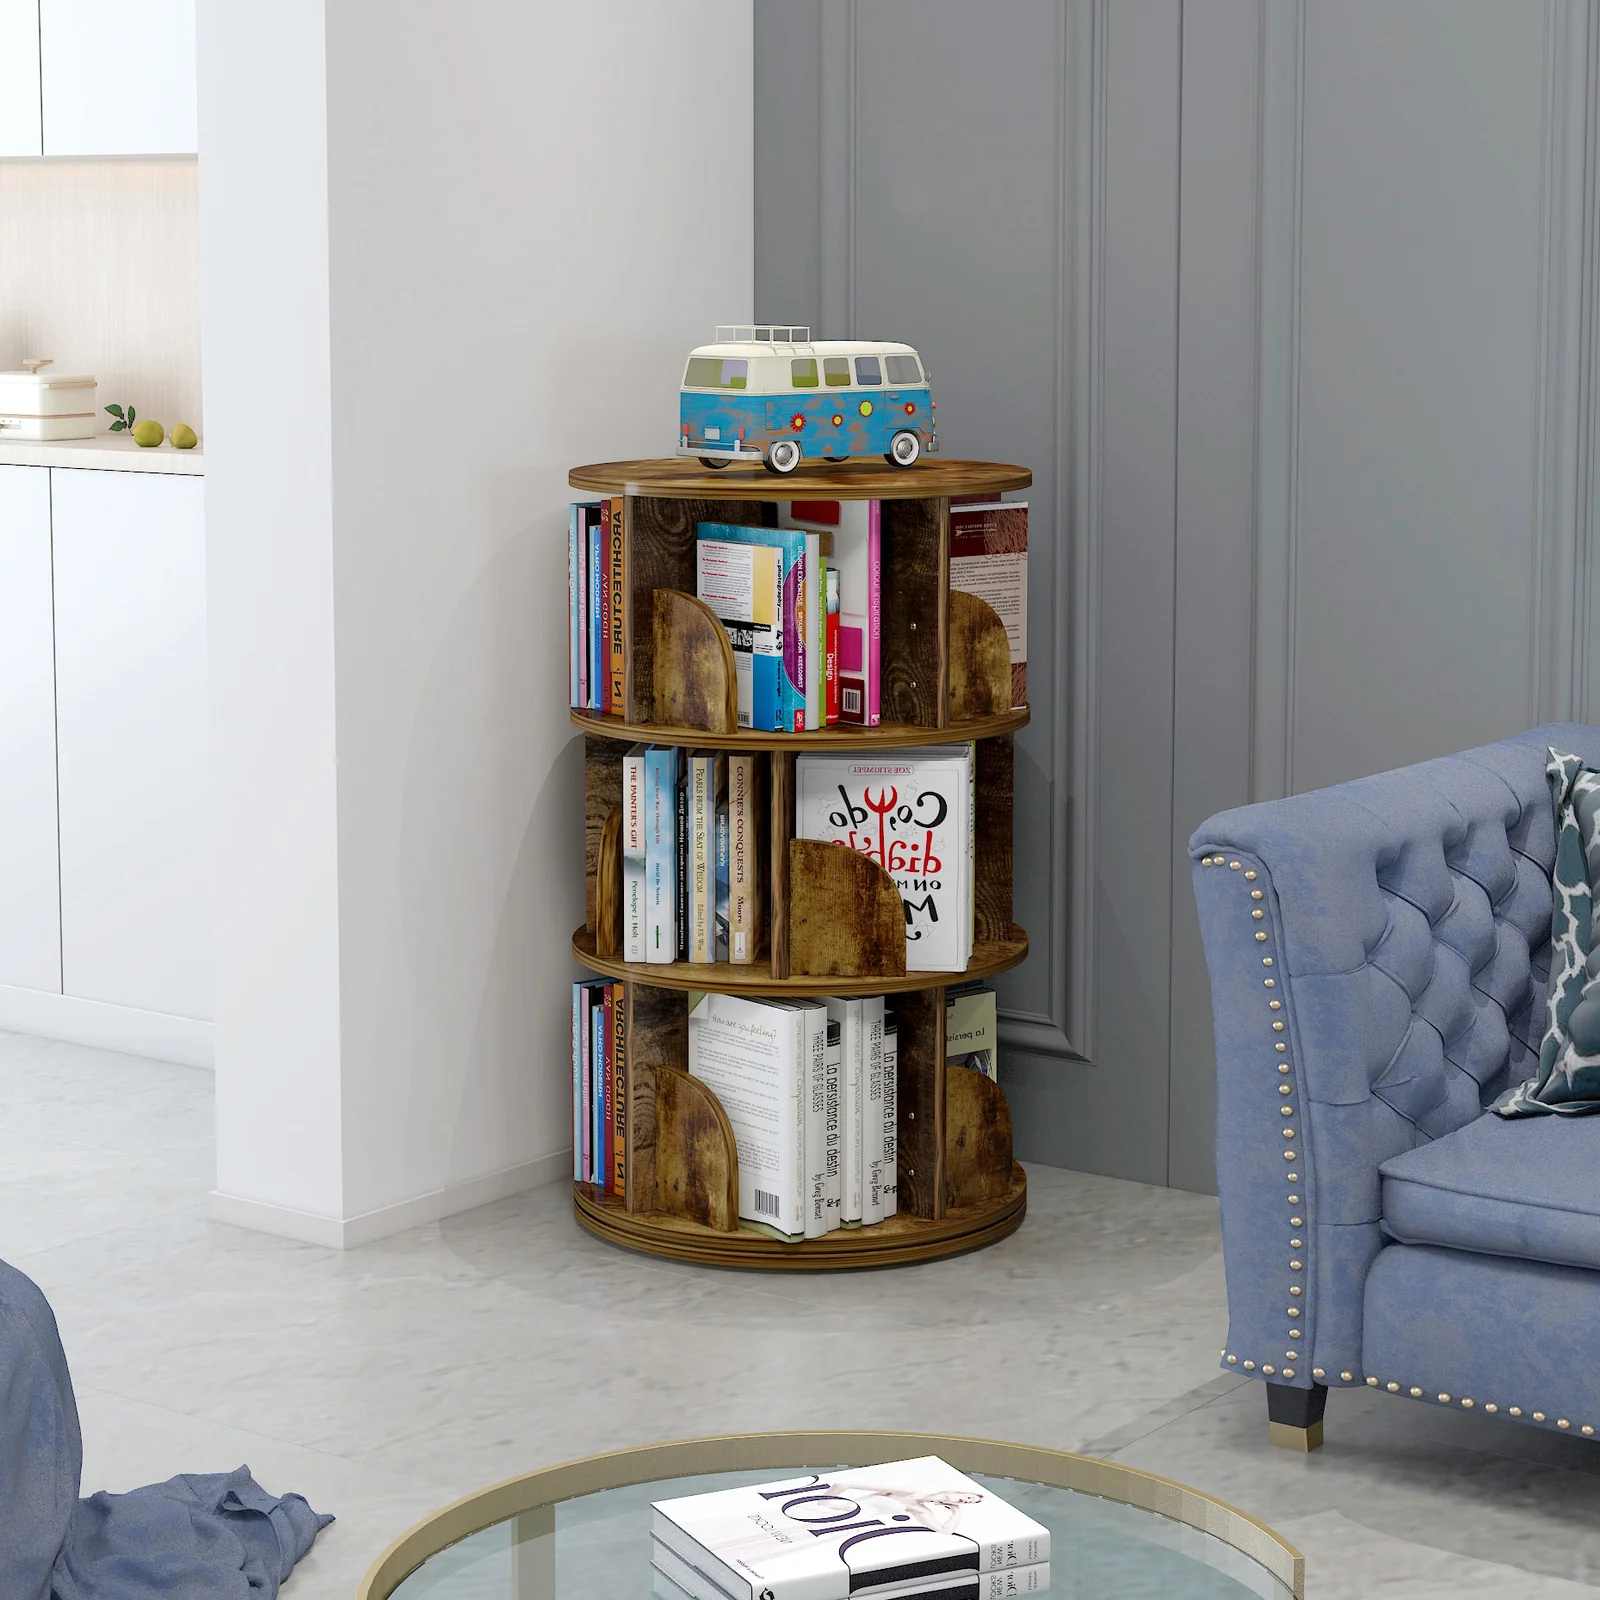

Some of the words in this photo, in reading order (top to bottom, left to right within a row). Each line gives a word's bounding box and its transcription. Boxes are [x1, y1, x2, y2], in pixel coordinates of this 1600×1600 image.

[870, 591, 880, 640] inspiration
[826, 653, 834, 681] Design
[696, 768, 704, 794] PEARLS
[736, 766, 744, 817] CONNIE'S
[696, 795, 704, 815] FROM
[696, 816, 704, 831] THE
[695, 831, 704, 850] SEAT
[735, 818, 744, 883] CONQUESTS
[696, 851, 704, 861] OF
[695, 862, 704, 893] WISDOM
[630, 880, 638, 913] Penelope
[696, 903, 704, 920] Edited
[750, 1023, 777, 1043] feeling?
[870, 1020, 881, 1041] THREE
[812, 1031, 824, 1053] THREE
[870, 1042, 881, 1061] PAIRS
[812, 1053, 824, 1073] PAIRS
[870, 1062, 881, 1071] OF
[884, 1051, 897, 1065] La
[813, 1073, 824, 1082] OF
[827, 1063, 840, 1075] La
[870, 1072, 881, 1101] GLASSES
[884, 1065, 898, 1119] persistance
[812, 1083, 824, 1113] GLASSES
[826, 1076, 841, 1131] persistance
[884, 1121, 898, 1134] du
[827, 1133, 841, 1147] du
[884, 1136, 898, 1164] destin
[827, 1149, 841, 1178] destin
[870, 1160, 882, 1168] by
[812, 1173, 825, 1182] by
[869, 1168, 882, 1185] Greg
[811, 1182, 824, 1198] Greg
